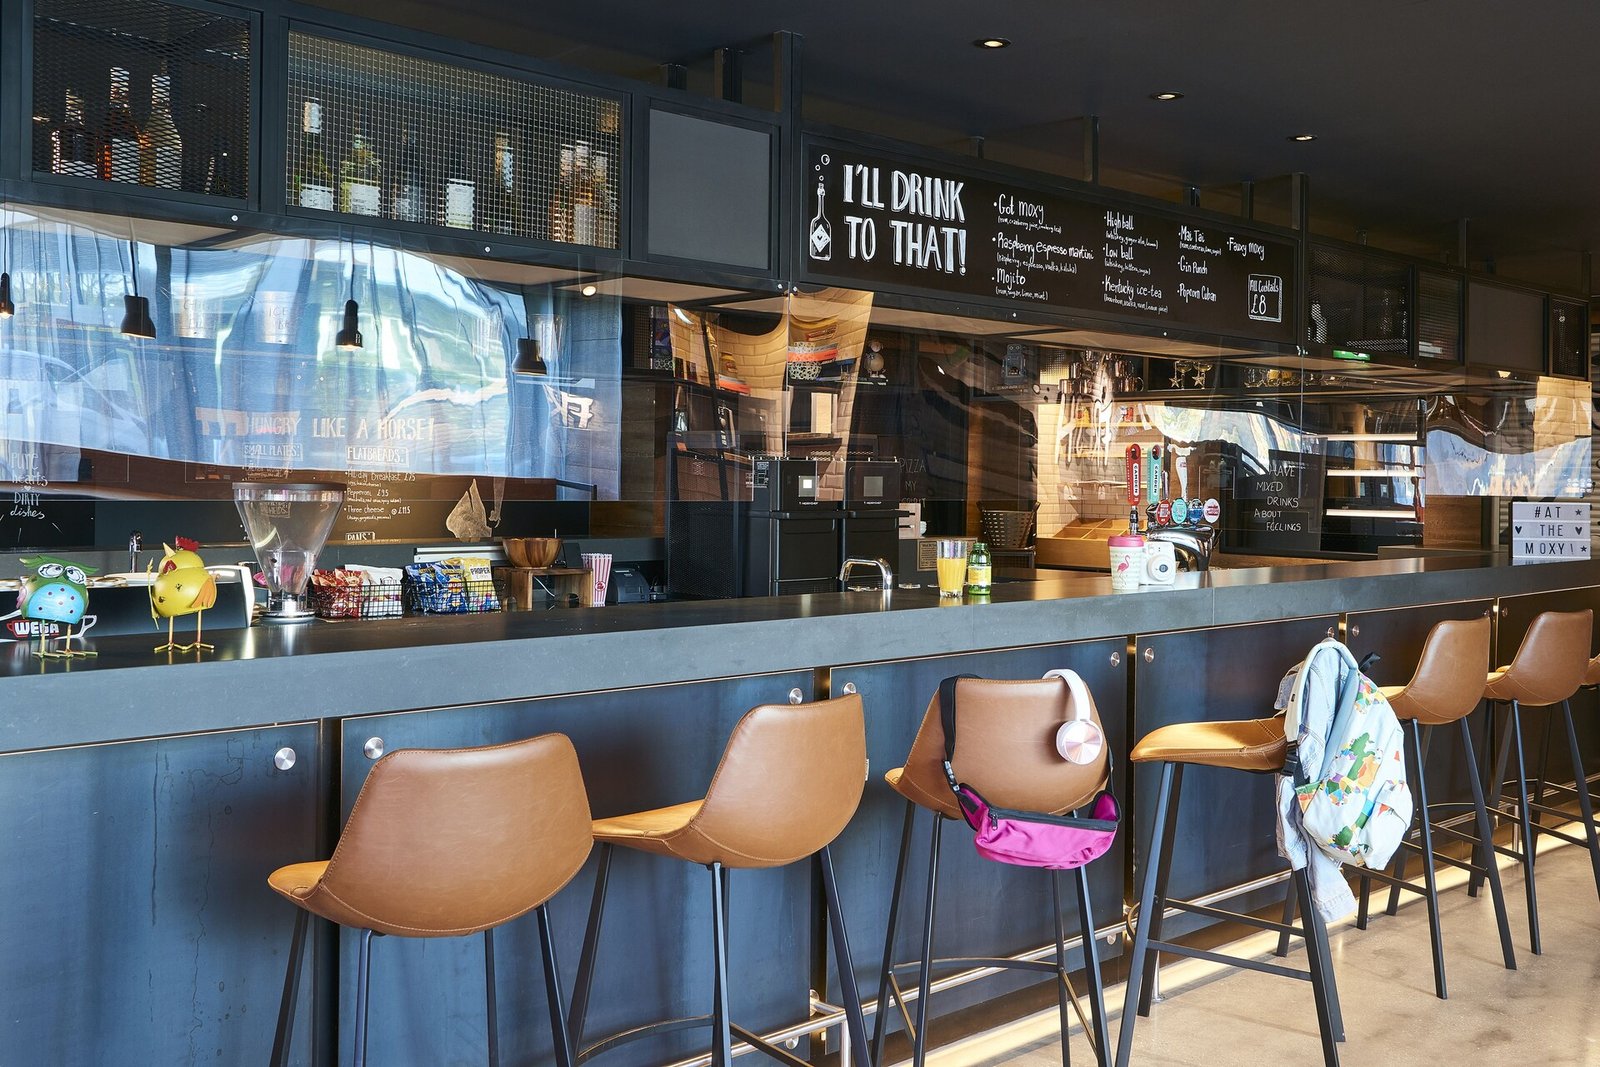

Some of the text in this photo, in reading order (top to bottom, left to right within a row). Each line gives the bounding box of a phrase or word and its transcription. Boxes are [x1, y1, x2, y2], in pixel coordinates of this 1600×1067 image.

[843, 164, 966, 223] I'LL DRINK
[998, 193, 1044, 225] Got moxy
[844, 215, 967, 275] TO THAT!
[997, 231, 1035, 264] Raspberry
[1180, 254, 1192, 273] Gin
[996, 267, 1026, 291] Mojito
[1250, 293, 1267, 315] £8
[247, 414, 302, 436] HUNGRY
[312, 417, 346, 438] LIKE
[356, 417, 369, 440] A
[244, 444, 268, 456] SMALL
[1268, 463, 1296, 478] HAVE
[1255, 481, 1284, 492] MIXED
[14, 491, 41, 507] DIRTY
[1266, 495, 1300, 509] DRINKS
[10, 504, 46, 520] dishes
[363, 503, 385, 515] cheese
[1253, 508, 1282, 518] ABOUT
[1534, 506, 1561, 518] #AT
[1540, 524, 1564, 537] THE
[14, 621, 60, 635] WEGA
